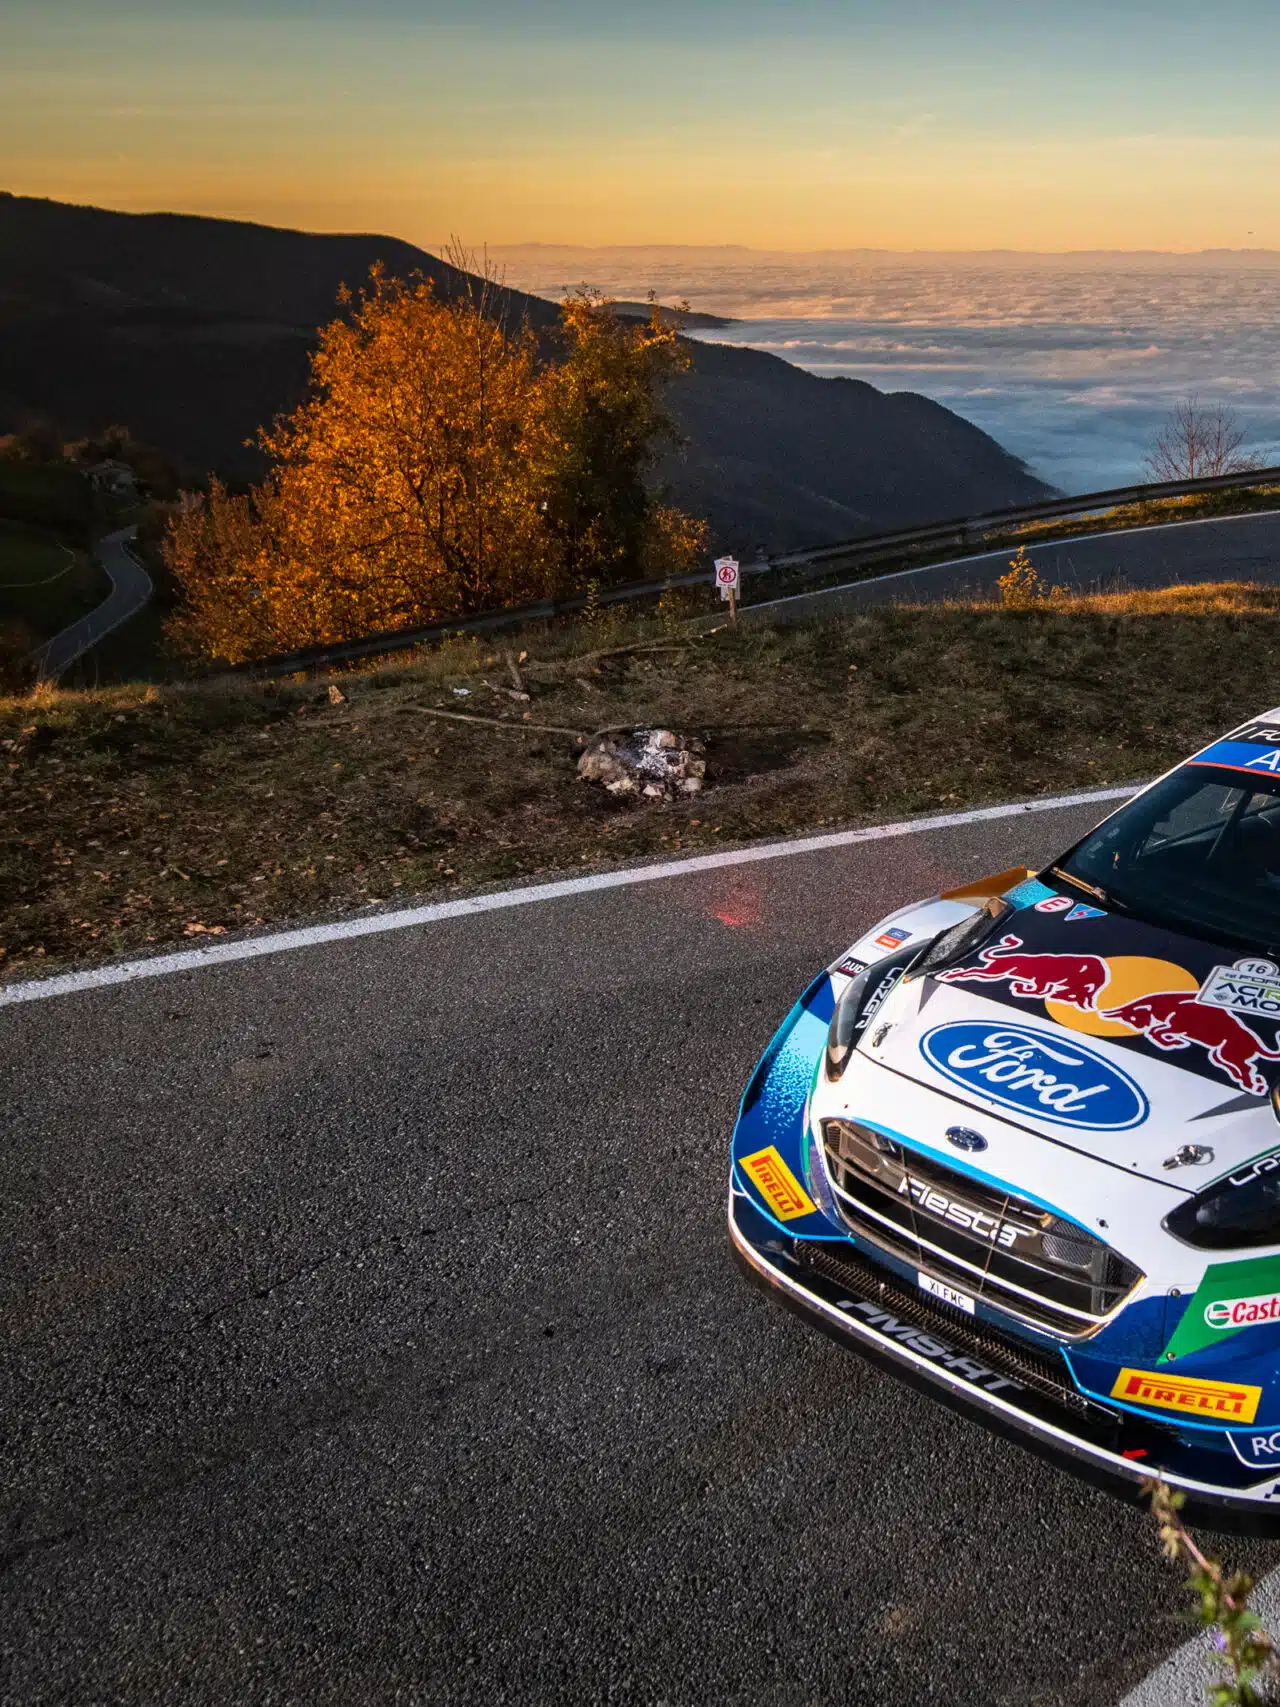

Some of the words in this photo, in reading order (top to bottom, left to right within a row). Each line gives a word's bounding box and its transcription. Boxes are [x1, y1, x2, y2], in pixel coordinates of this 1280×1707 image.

[1246, 963, 1268, 975] 16
[947, 1031, 1099, 1113] Ford
[750, 1155, 804, 1213] PIRELLI
[1125, 1376, 1248, 1414] PIRELLI
